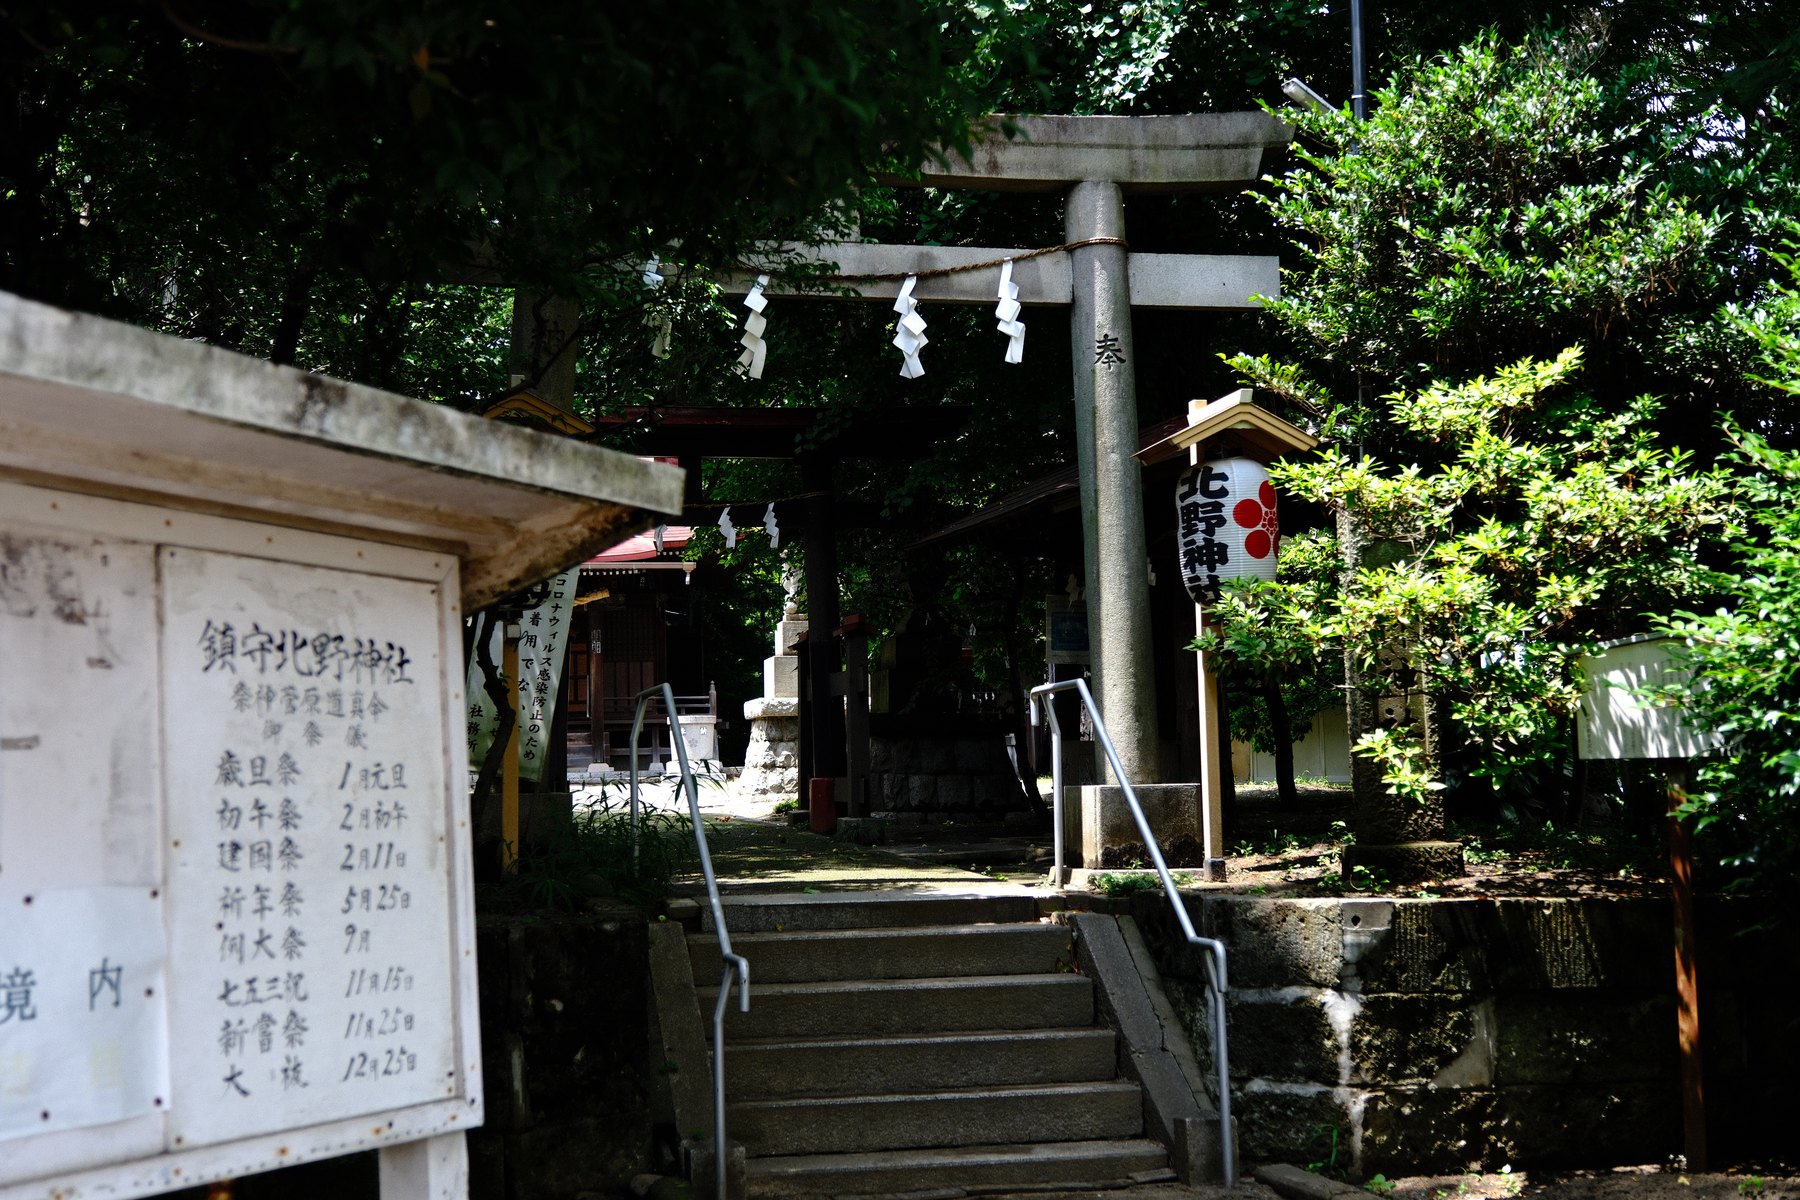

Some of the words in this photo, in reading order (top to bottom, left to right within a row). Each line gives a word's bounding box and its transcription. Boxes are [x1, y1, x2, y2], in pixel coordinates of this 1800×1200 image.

[1094, 333, 1127, 371] 奉
[1179, 465, 1229, 606] 北野神社
[198, 619, 414, 685] 鎮守北野神社
[524, 572, 569, 760] コロナウィルス感染防止のため
[467, 704, 484, 752] 社務所
[214, 750, 301, 788] 歳旦祭
[338, 761, 408, 790] 1月元旦
[217, 798, 303, 831] 初午祭
[339, 800, 408, 831] 2月初午
[217, 836, 304, 872] 建国祭
[339, 841, 407, 871] 2月11日
[218, 882, 304, 921] 祈年祭
[341, 884, 411, 914] 5月25日
[344, 923, 370, 955] 9月
[217, 971, 309, 1008] 七五三祝
[344, 966, 414, 999] 11月15日
[344, 1006, 415, 1040] 11月25日
[341, 1046, 417, 1082] 12月25日
